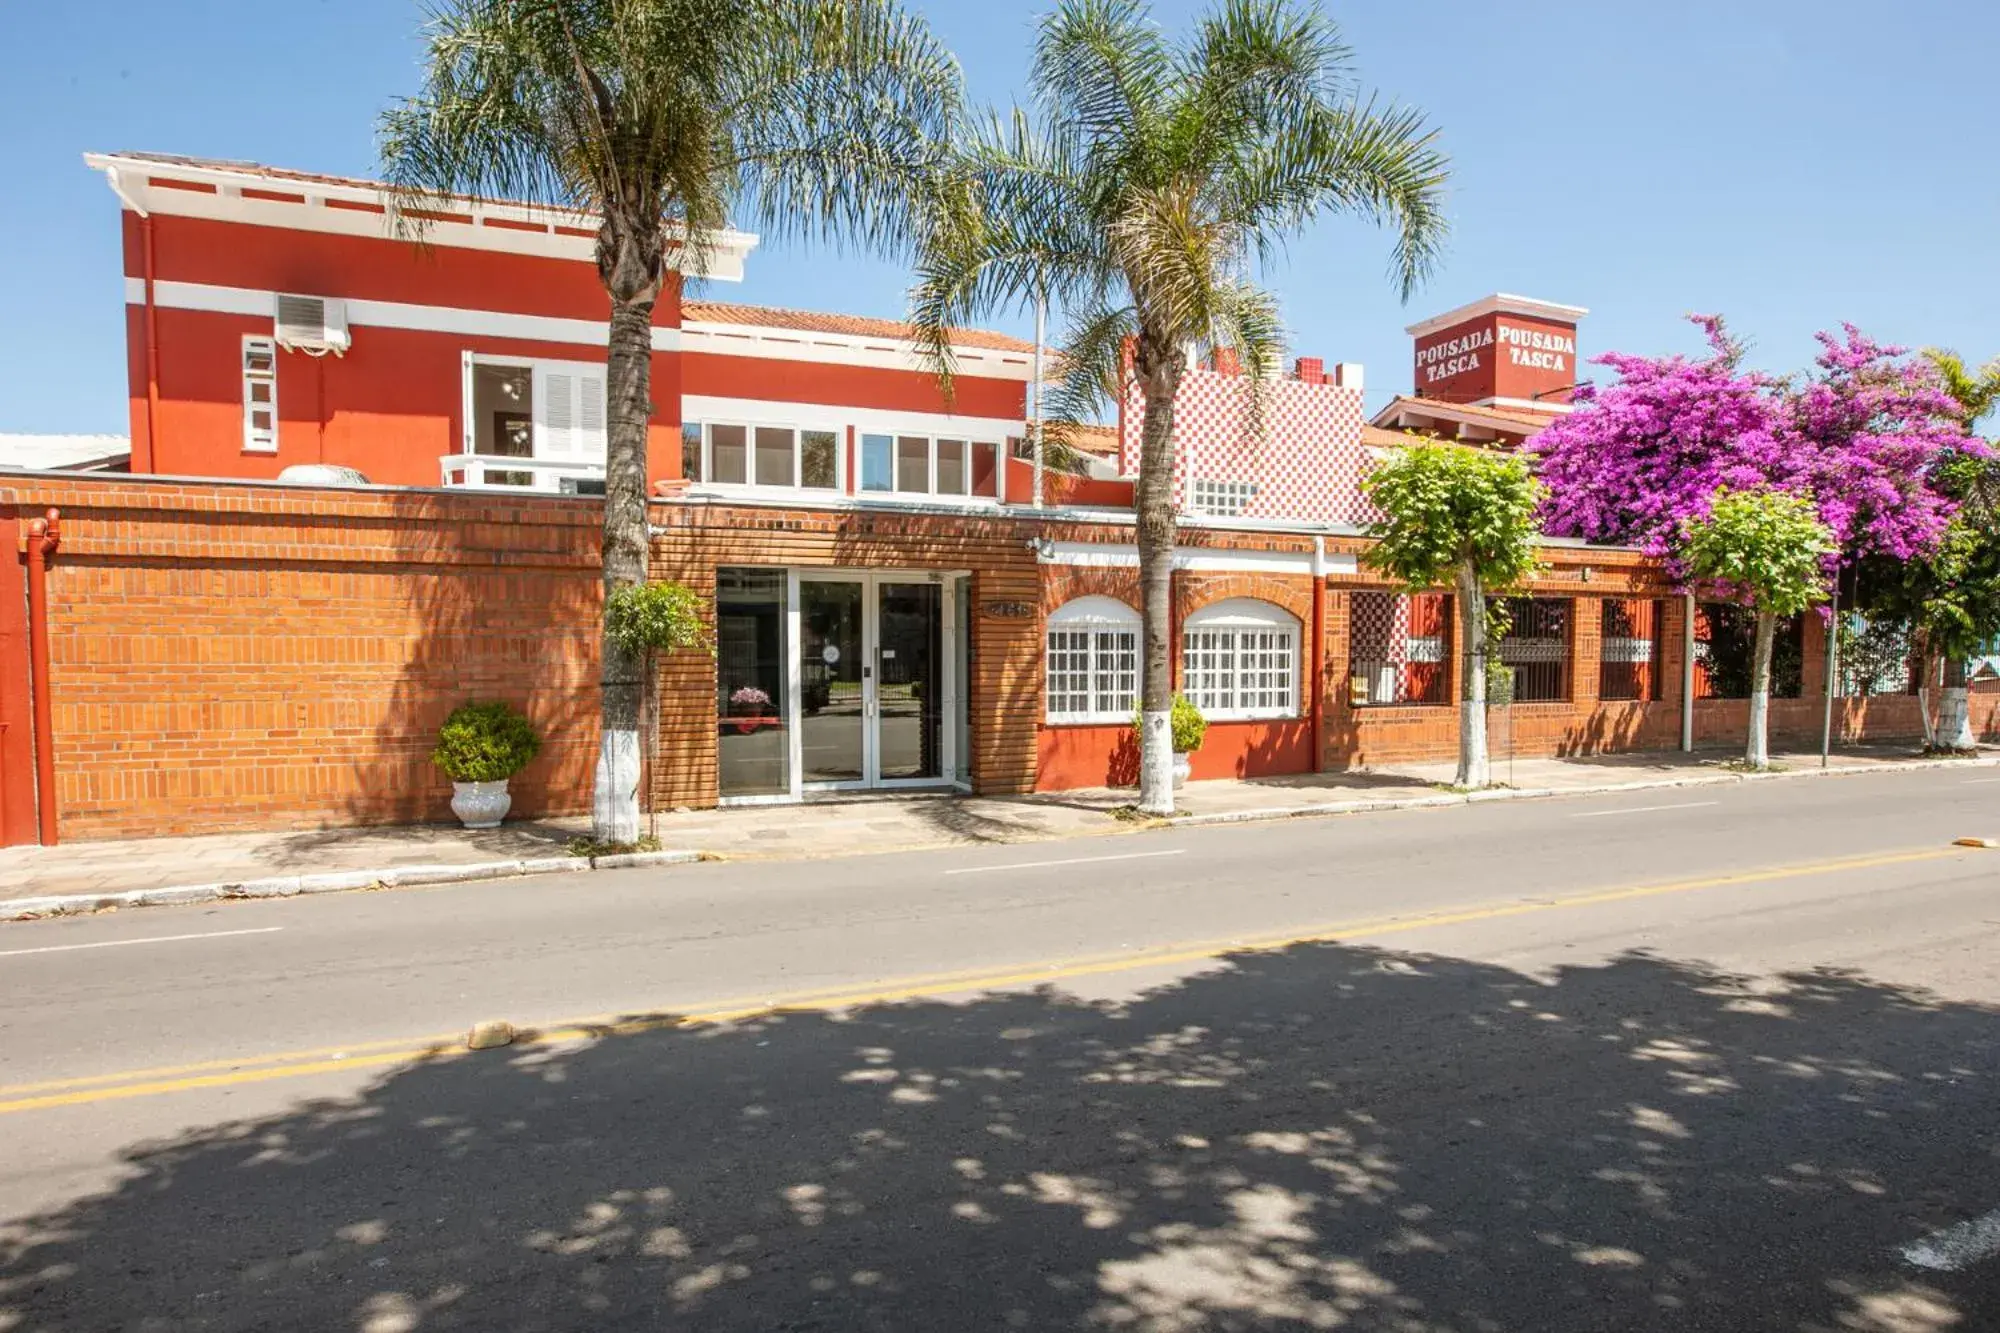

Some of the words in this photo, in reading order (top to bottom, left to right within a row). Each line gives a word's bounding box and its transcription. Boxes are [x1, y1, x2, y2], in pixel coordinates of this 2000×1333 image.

[1416, 328, 1494, 368] POUSADA
[1498, 325, 1575, 354] POUSADA
[1427, 353, 1480, 382] TASCA
[1509, 347, 1565, 372] TASCA
